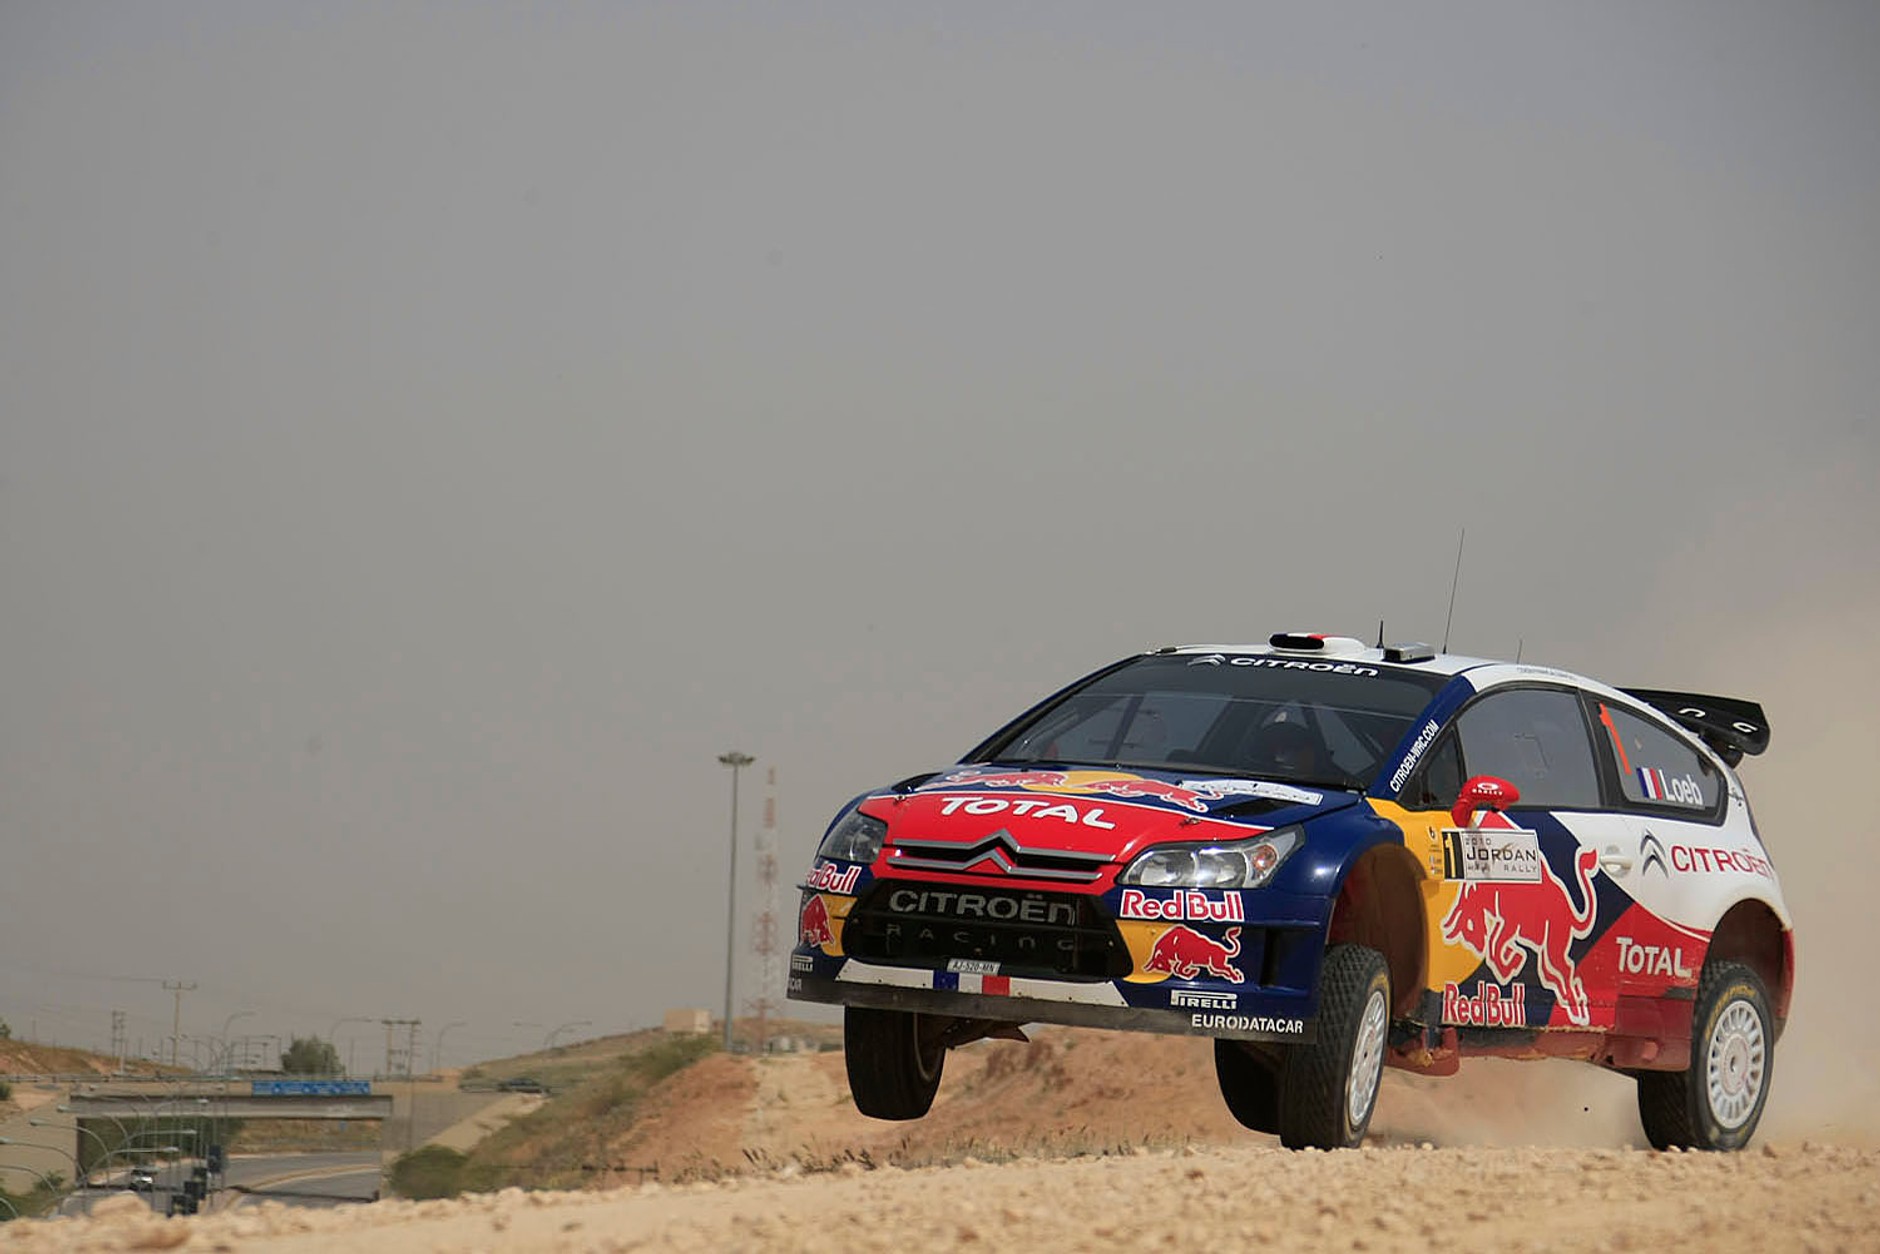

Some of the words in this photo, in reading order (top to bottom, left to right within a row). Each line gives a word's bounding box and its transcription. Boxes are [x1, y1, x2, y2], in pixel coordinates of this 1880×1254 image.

[1658, 768, 1704, 806] Loeb
[941, 796, 1116, 830] TOTAL
[1444, 832, 1456, 879] 1
[1466, 846, 1537, 862] JORDAN
[1503, 864, 1537, 873] RALLY
[816, 862, 862, 894] Bull
[1120, 889, 1184, 918] Red
[1186, 890, 1244, 922] Bull
[1616, 936, 1692, 979] TOTAL
[1170, 989, 1238, 1010] PIRELLI
[1442, 980, 1485, 1025] Red
[1485, 982, 1526, 1028] Bull
[1191, 1013, 1304, 1034] EURODATACAR
